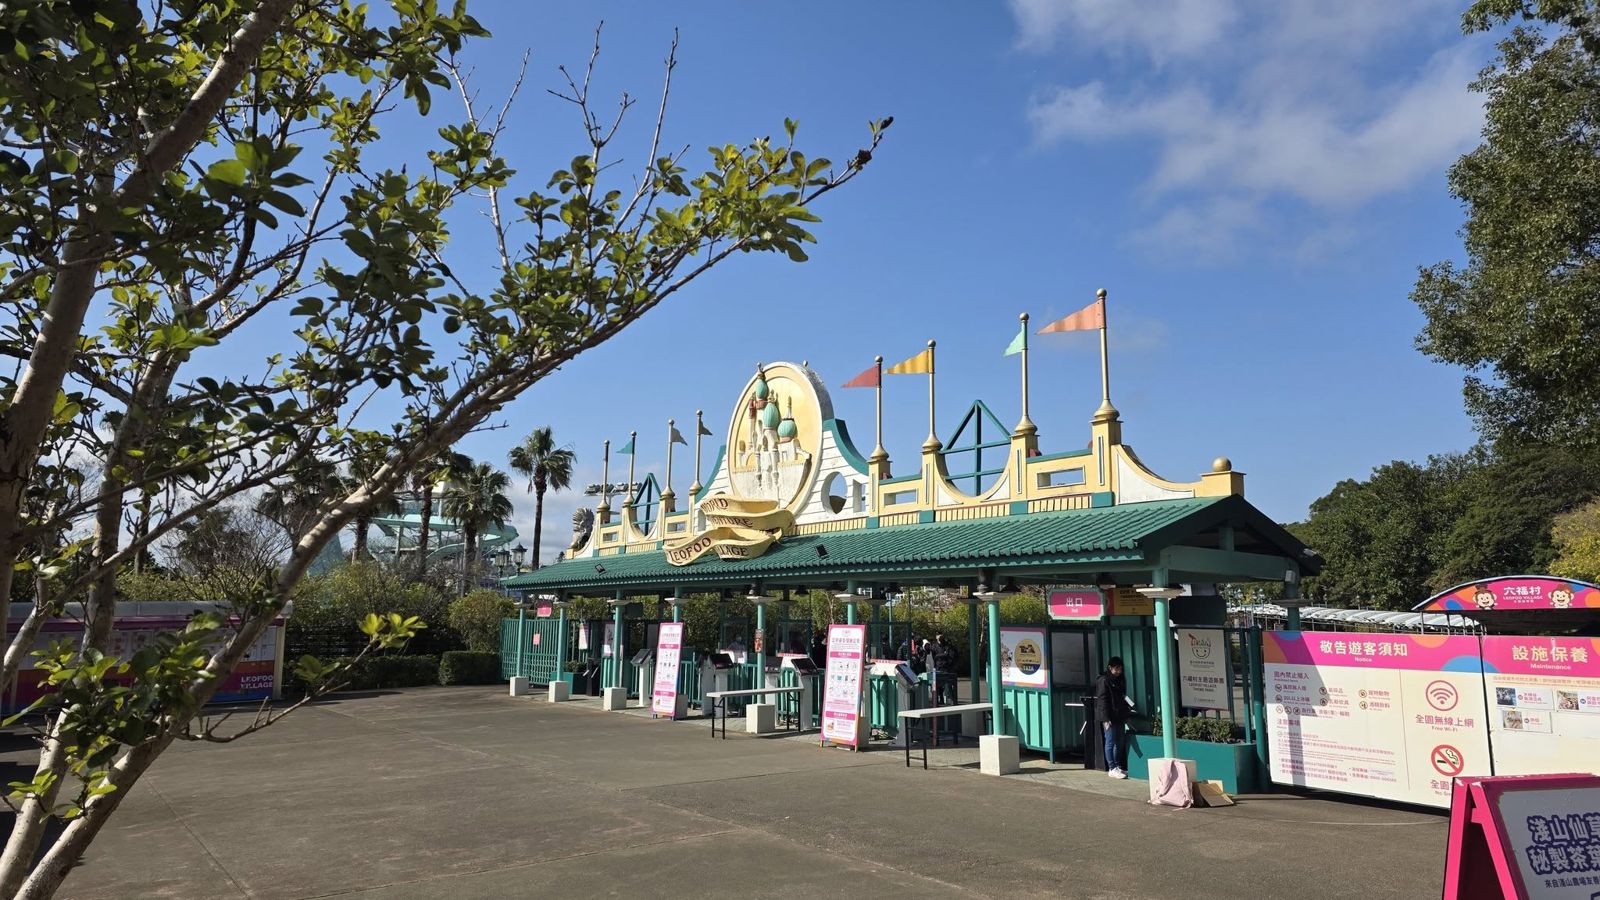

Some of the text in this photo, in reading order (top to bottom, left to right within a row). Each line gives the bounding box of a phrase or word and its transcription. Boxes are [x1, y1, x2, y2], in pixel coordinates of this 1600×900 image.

[669, 537, 711, 563] LEOFOO
[1503, 585, 1542, 596] 六福村
[1066, 597, 1083, 607] 出口
[1320, 640, 1408, 656] 敬告遊客須知
[1512, 645, 1588, 663] 設施保養
[1416, 714, 1474, 728] 全園無線上網
[1430, 779, 1452, 790] 全園
[1544, 876, 1600, 888] 來自淺山農場友善
